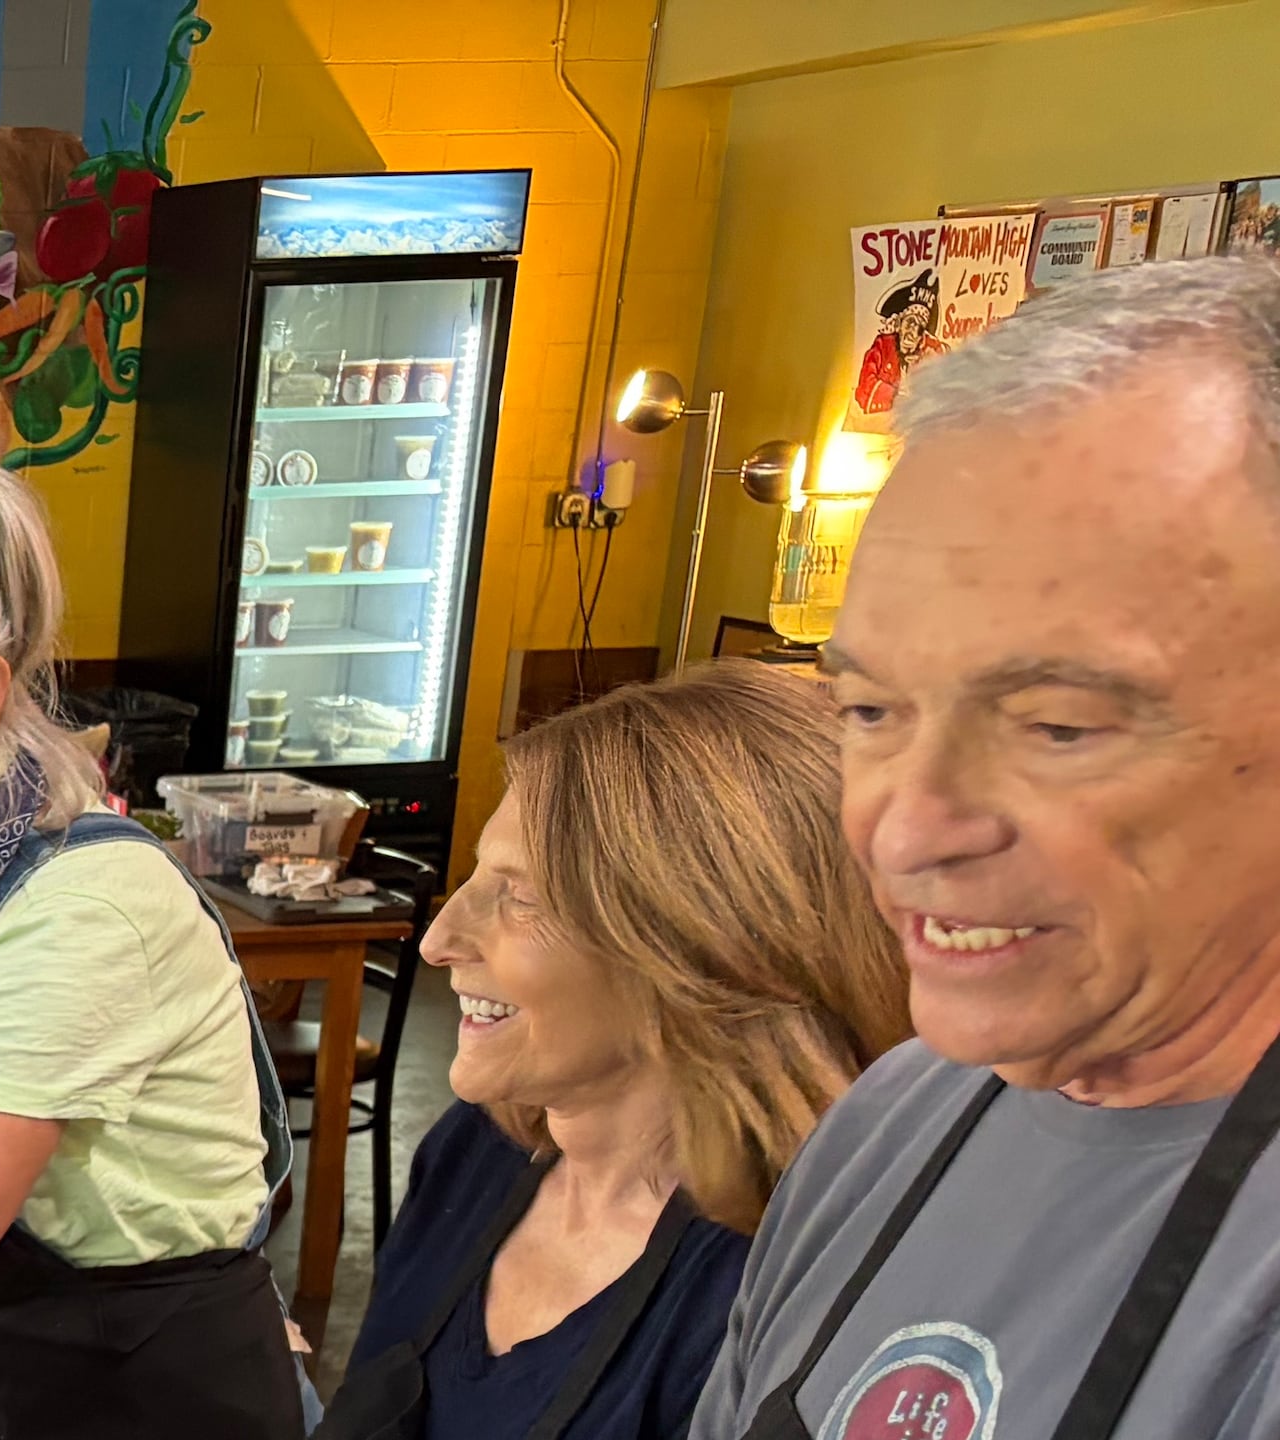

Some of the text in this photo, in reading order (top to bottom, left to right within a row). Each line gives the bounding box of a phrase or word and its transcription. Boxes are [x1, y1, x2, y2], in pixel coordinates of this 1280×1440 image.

[861, 221, 1030, 277] STONE MOUNTAIN HIGH
[1040, 240, 1097, 255] COMMUNITY
[1051, 253, 1084, 266] BOARD
